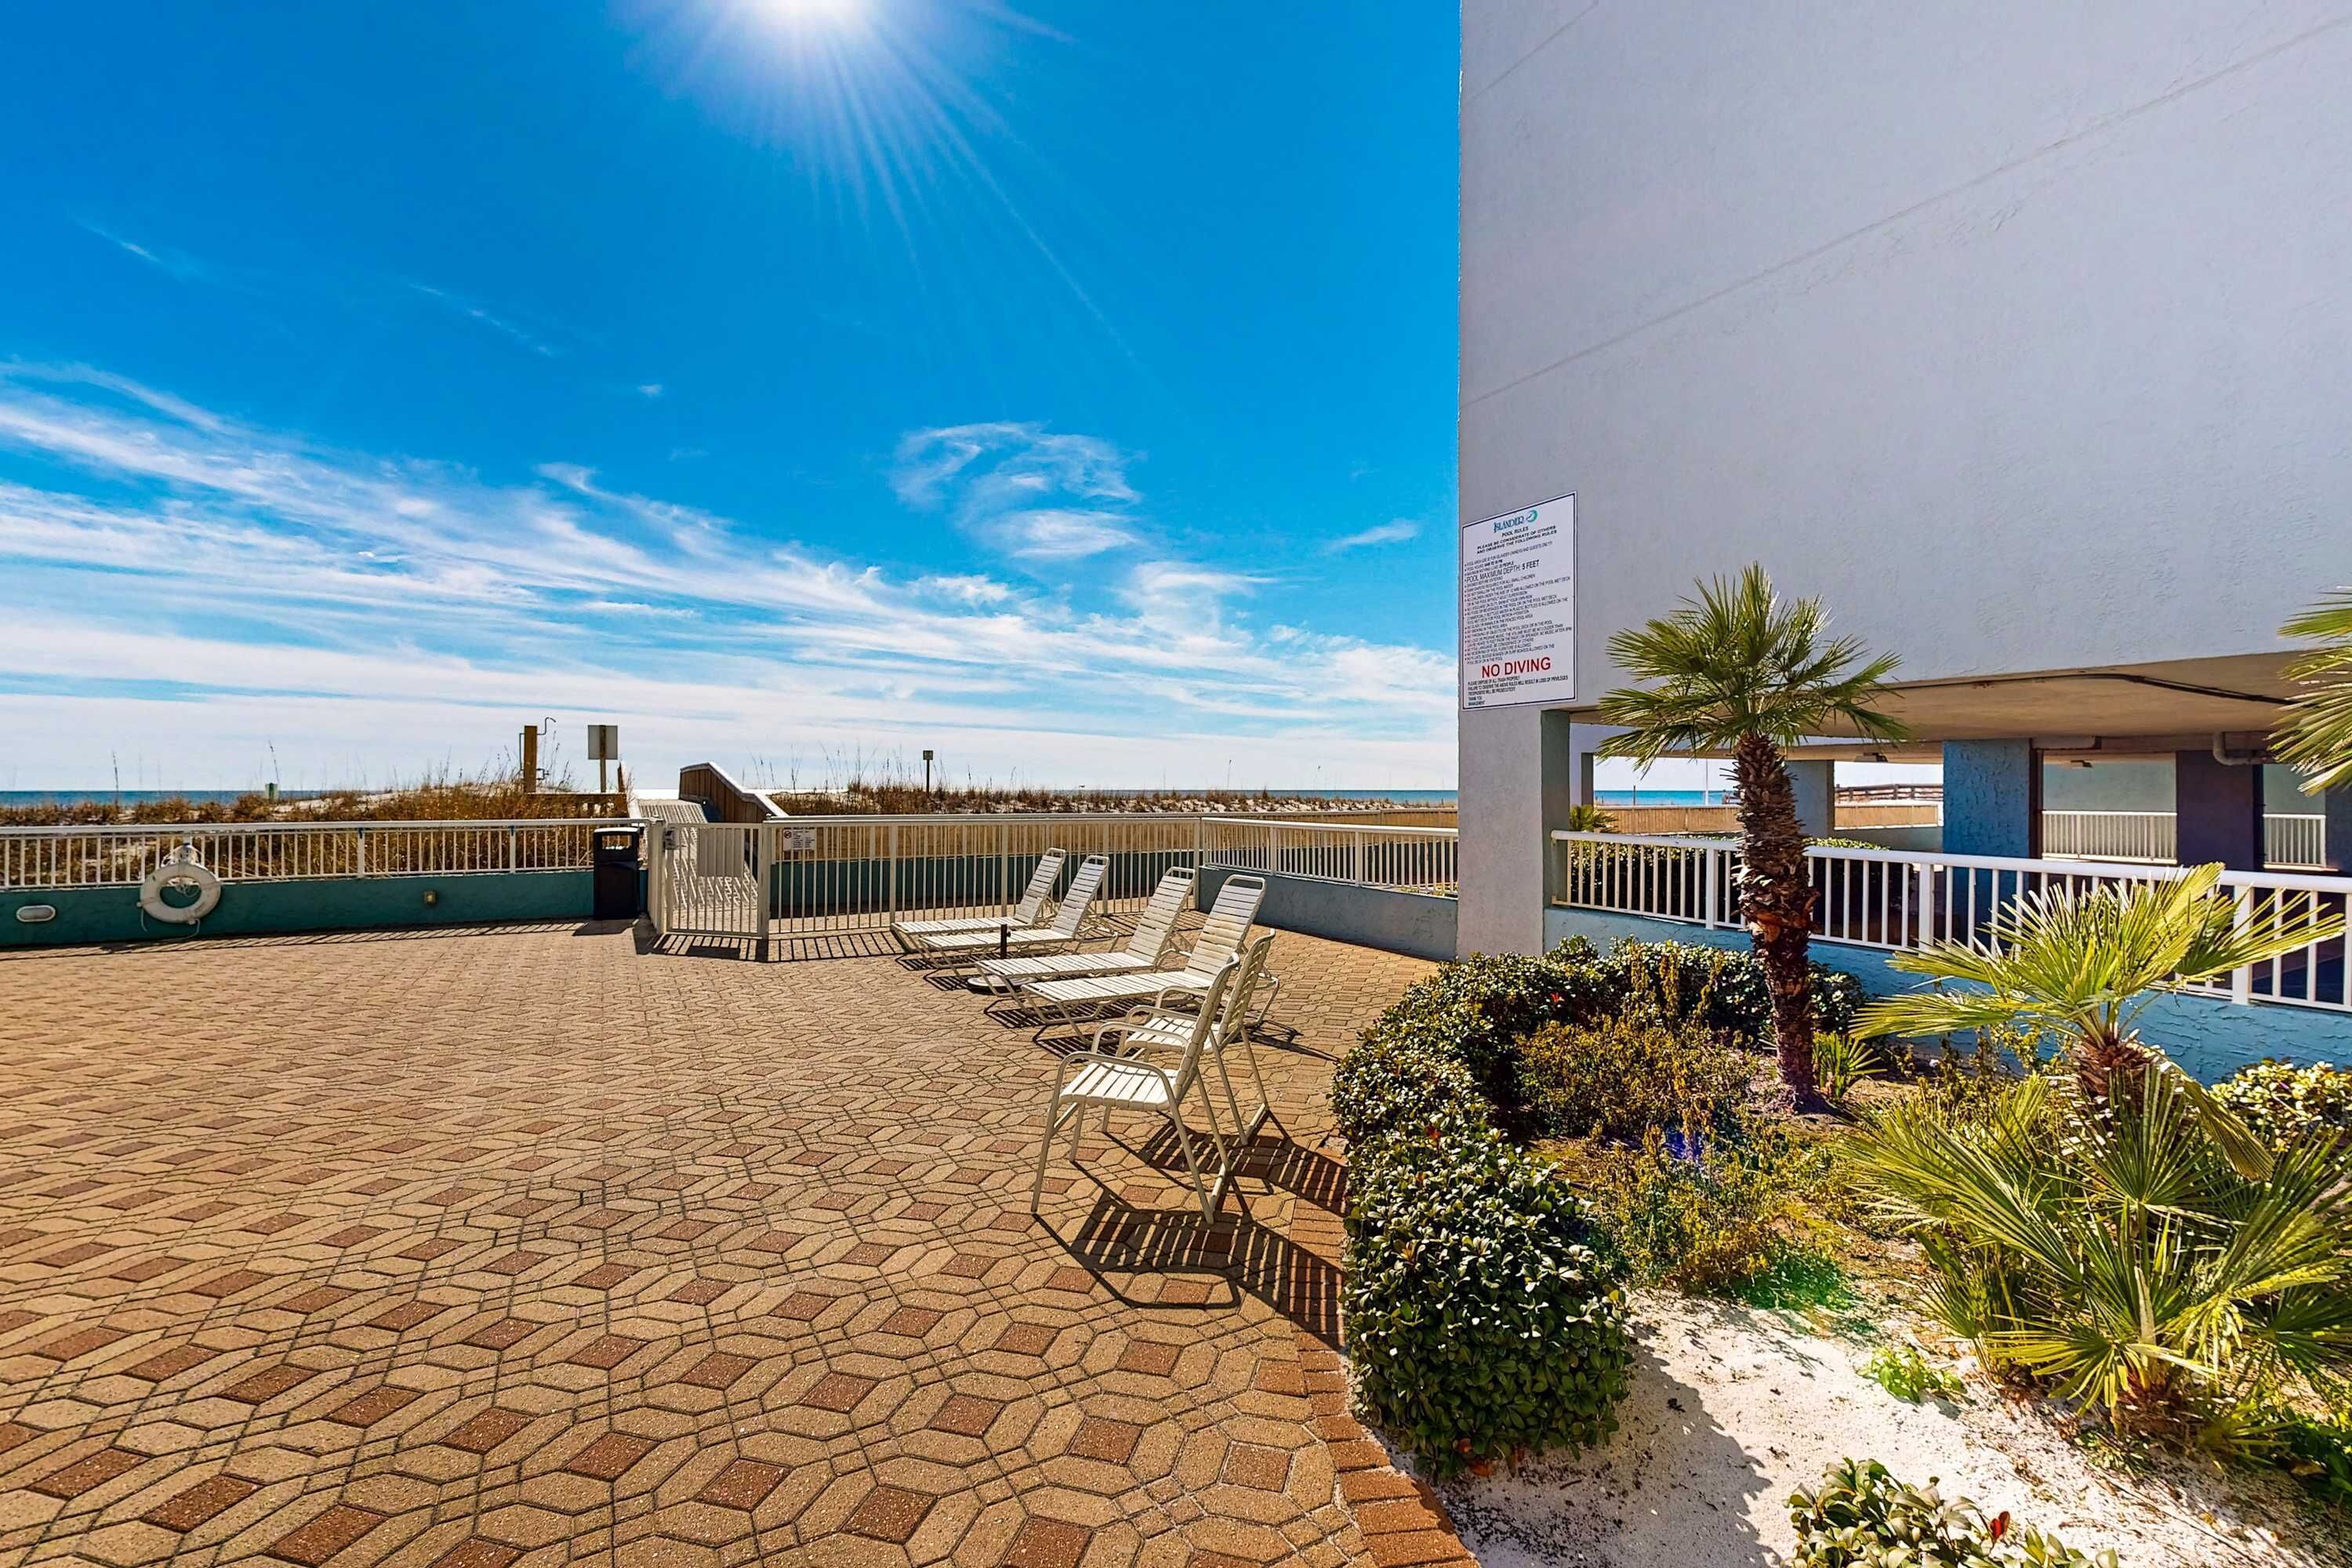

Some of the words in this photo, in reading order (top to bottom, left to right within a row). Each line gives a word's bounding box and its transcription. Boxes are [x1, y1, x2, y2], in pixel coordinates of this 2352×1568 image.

[1494, 516, 1524, 533] ISLANDER
[1486, 543, 1504, 552] OBSERVE
[1515, 534, 1541, 544] FOLLOWING
[1500, 533, 1529, 544] CONSIDERATE
[1537, 525, 1556, 534] OTHERS
[1467, 575, 1479, 583] POOL
[1479, 568, 1502, 580] MAXIMUM
[1526, 559, 1540, 569] FEET
[1482, 664, 1500, 677] NO
[1504, 657, 1551, 674] DIVING
